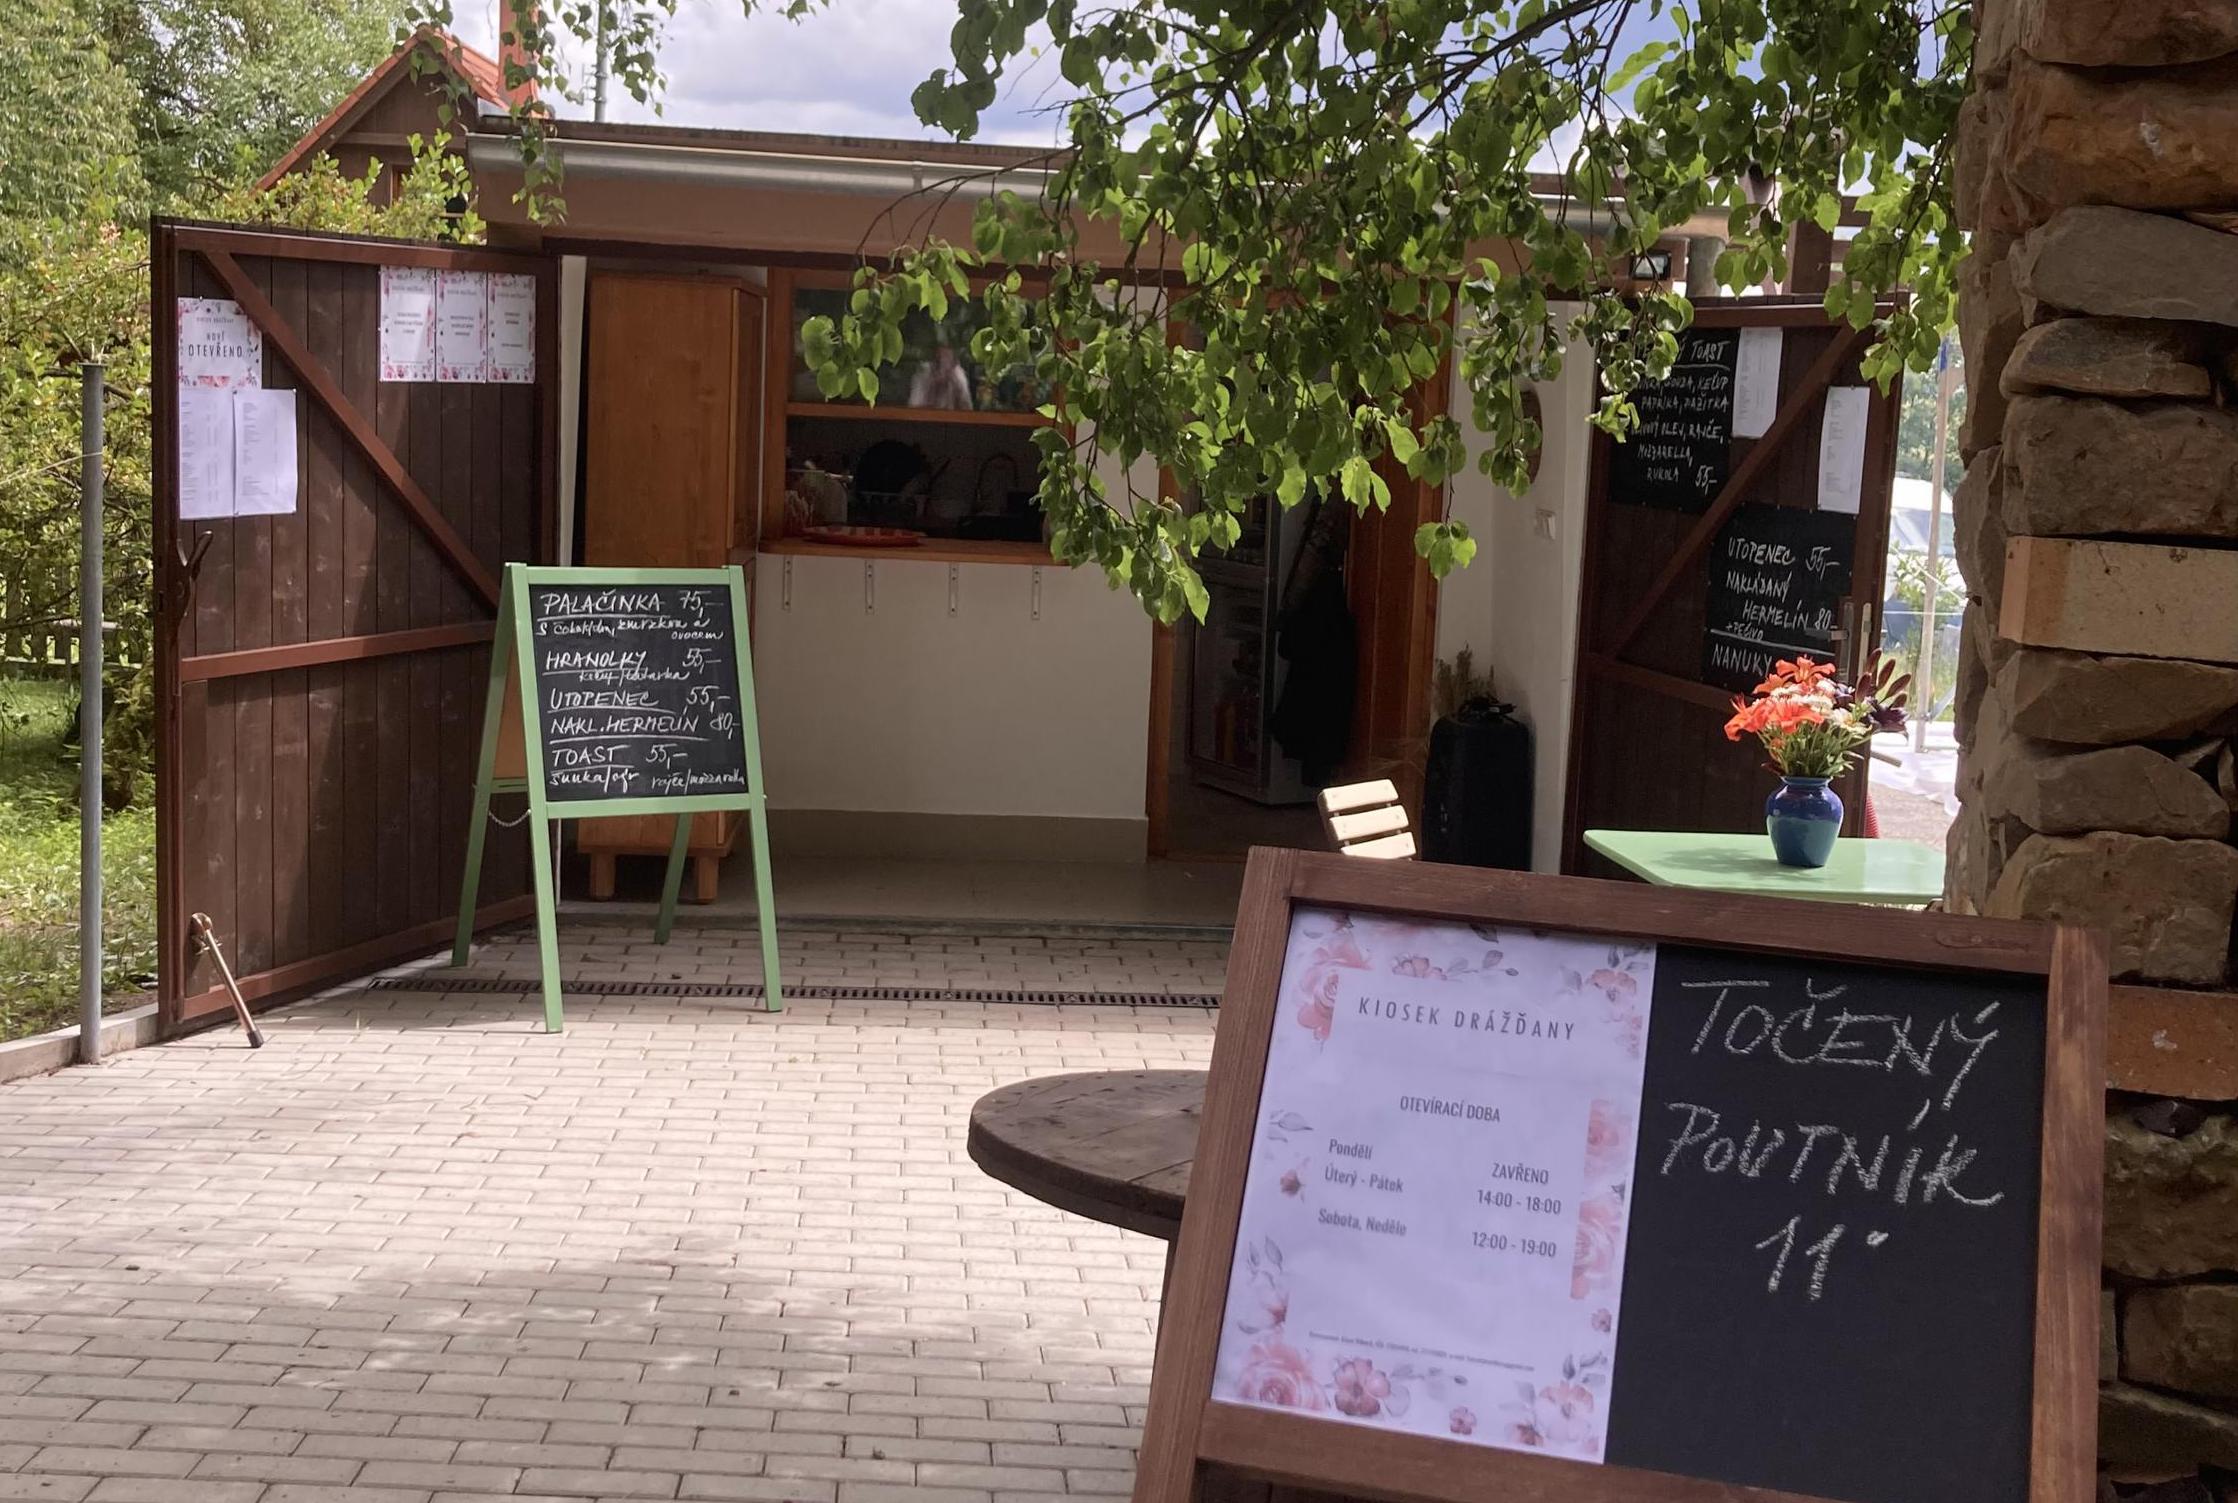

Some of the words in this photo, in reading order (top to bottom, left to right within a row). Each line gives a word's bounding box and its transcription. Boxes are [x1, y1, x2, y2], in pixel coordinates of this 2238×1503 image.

[188, 341, 243, 358] OTEVŘENO
[1691, 340, 1731, 362] TOAST
[1728, 535, 1796, 566] UTOPENEC
[1725, 569, 1793, 604] NAKLÁDANÝ
[539, 589, 666, 615] PALAČINKA
[1742, 600, 1810, 631] HERMELÍN
[544, 649, 648, 672] HRANOLKY
[1711, 643, 1773, 679] NANUKY
[550, 687, 660, 710] UTOPENEC
[551, 744, 632, 767] TOAST
[1358, 997, 1441, 1026] KIOSEK
[1453, 1009, 1575, 1041] DRÁŽĎANY
[1680, 976, 2001, 1112] TOČENÝ
[1399, 1094, 1465, 1119] OTEVÍRACÍ
[1466, 1103, 1502, 1123] DOBA
[1328, 1137, 1374, 1161] Pondělí
[1324, 1162, 1358, 1188] Úterý
[1369, 1172, 1405, 1194] Pátek
[1491, 1162, 1550, 1186] ZAVŘENO
[1476, 1188, 1514, 1209] 14:00
[1526, 1195, 1563, 1216] 18:00
[1317, 1207, 1363, 1232] Sobota,
[1365, 1215, 1408, 1238] Neděle
[1471, 1231, 1509, 1251] 12:00
[1520, 1238, 1558, 1259] 19:00
